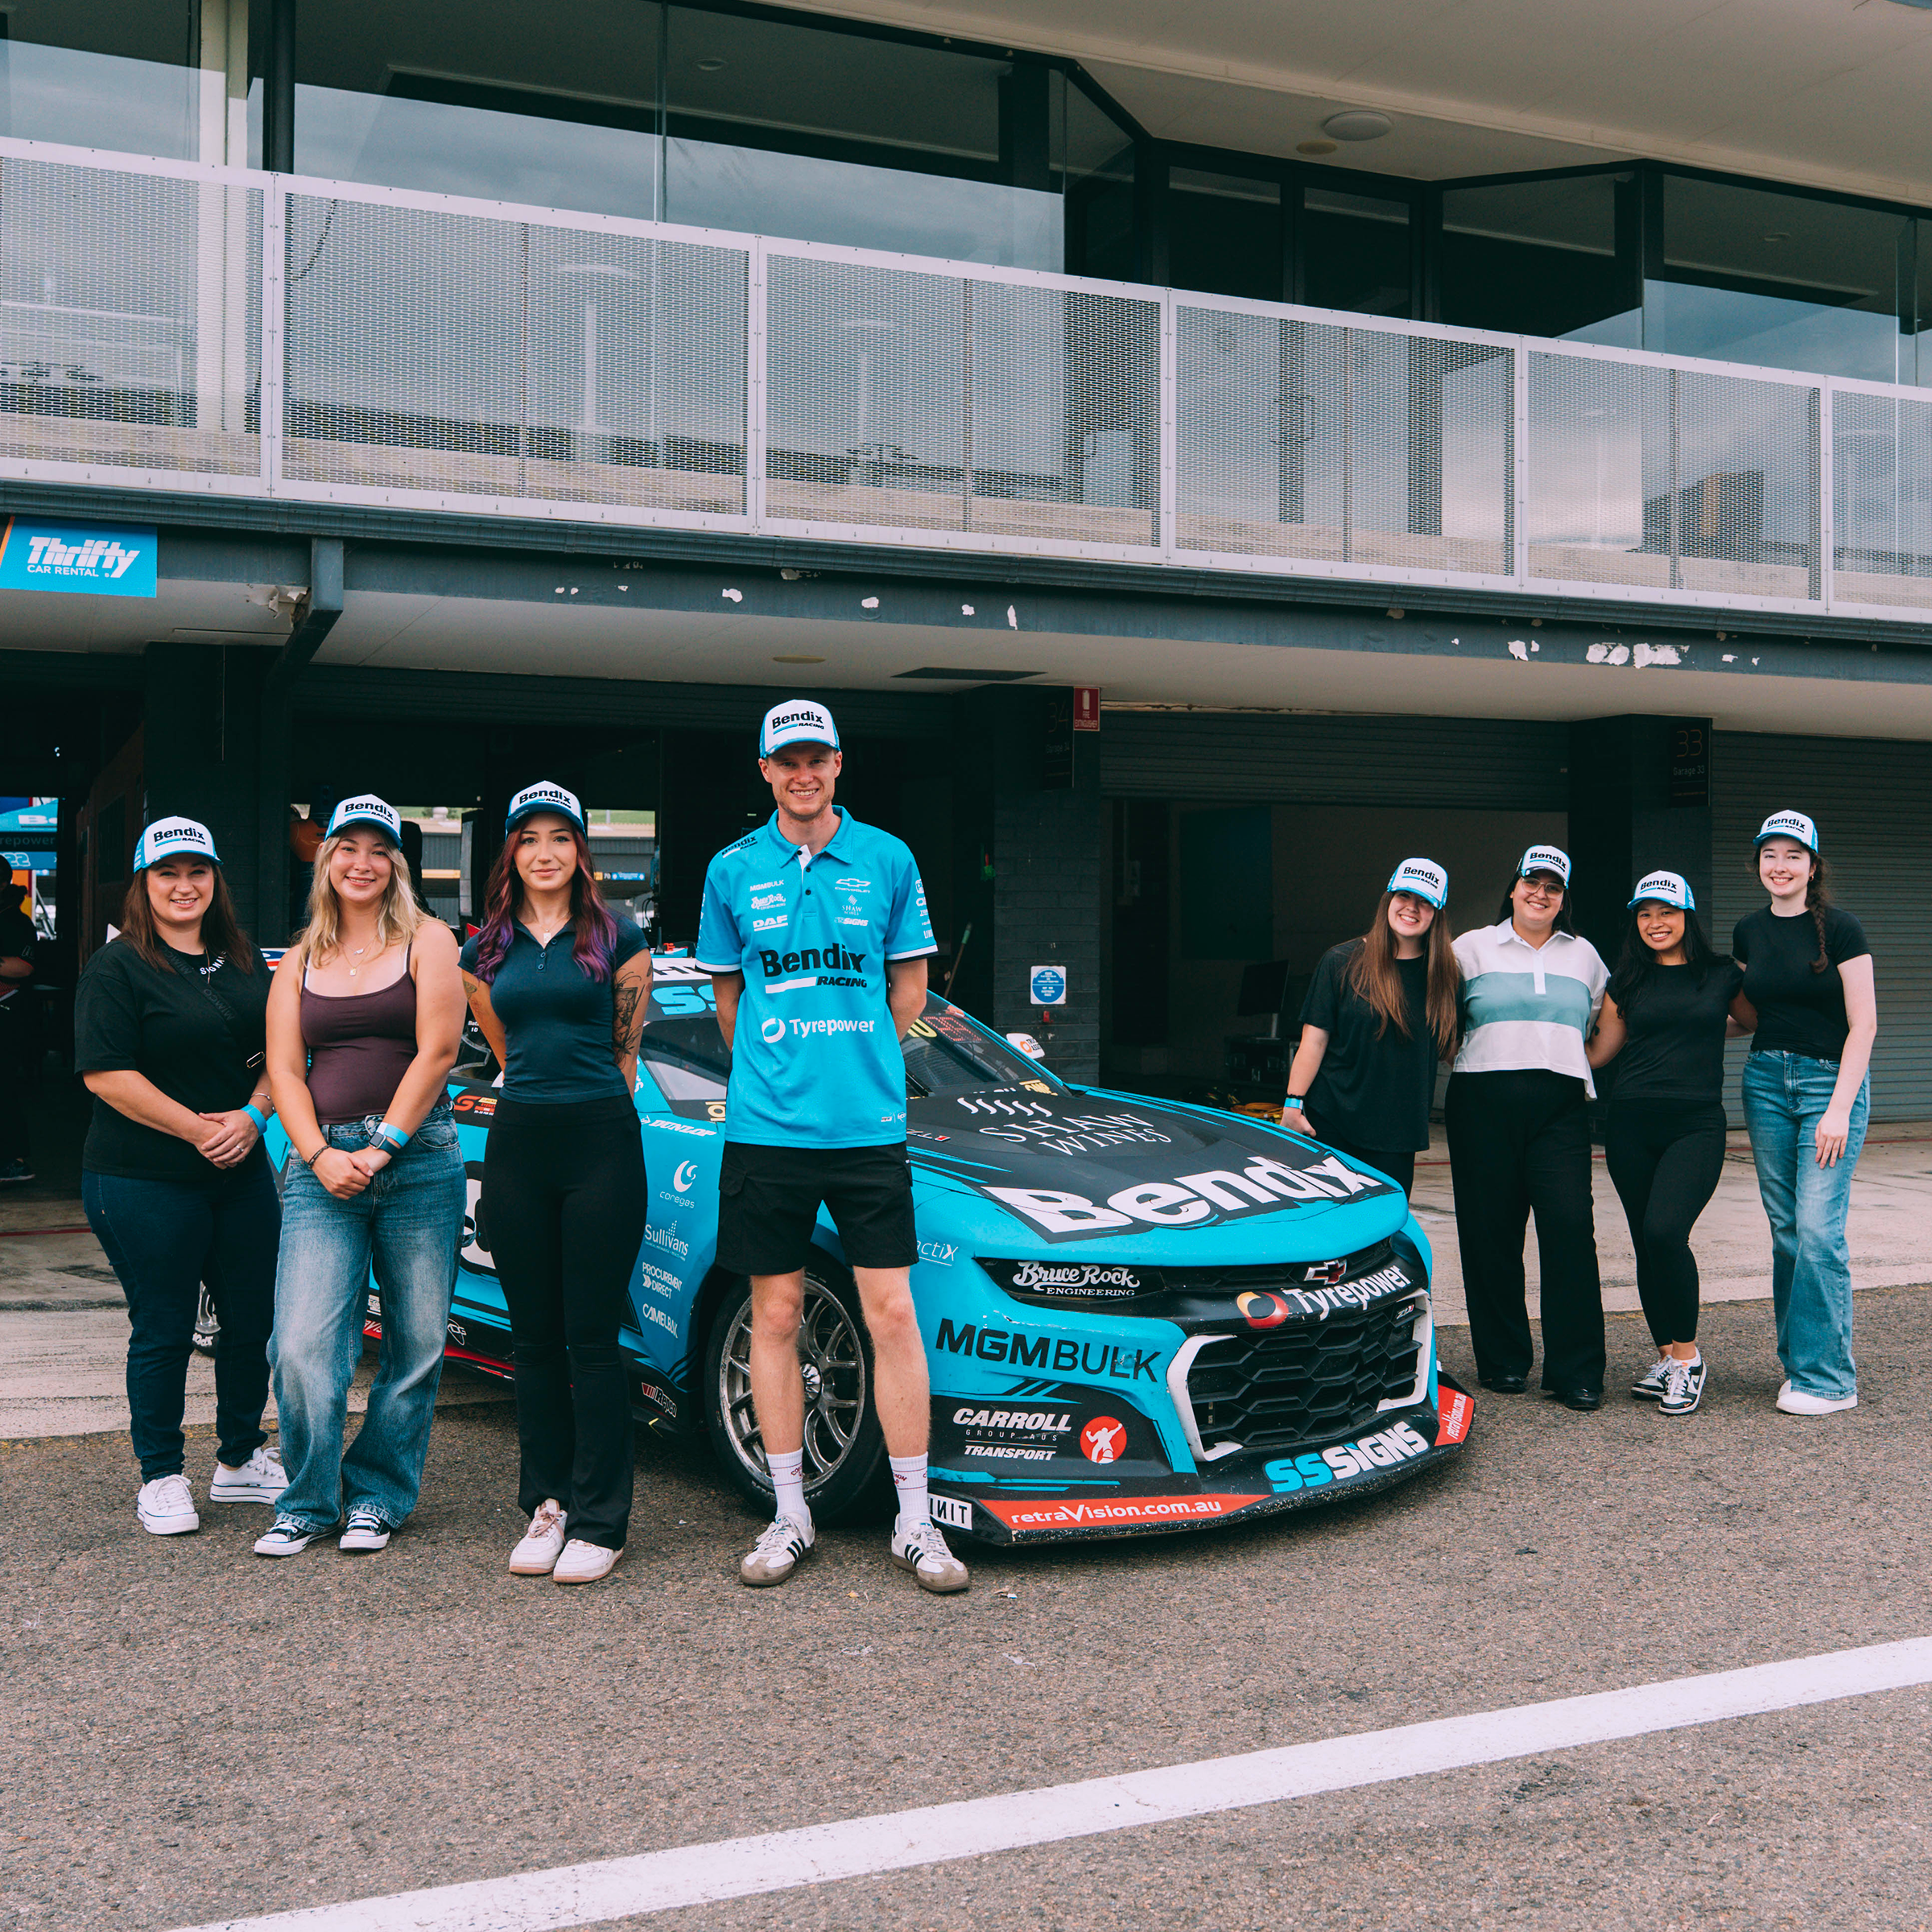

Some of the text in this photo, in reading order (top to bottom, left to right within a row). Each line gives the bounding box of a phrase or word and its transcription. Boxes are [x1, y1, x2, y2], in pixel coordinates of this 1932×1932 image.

[27, 536, 140, 578] Thrifty
[27, 565, 99, 577] CAR RENTAL
[771, 711, 824, 729] Bendix
[1677, 729, 1703, 758] 33
[519, 790, 571, 805] Bendix
[546, 798, 572, 808] RACING
[345, 803, 394, 820] Bendix
[1767, 818, 1806, 829] Bendix
[153, 827, 204, 842] Bendix
[181, 837, 206, 845] RACING
[1529, 852, 1567, 869] Bendix
[1403, 866, 1439, 885] Bendix
[1640, 879, 1677, 890] Bendix
[749, 879, 785, 892] MGMBULK
[753, 914, 787, 928] DAF
[759, 943, 866, 977] Bendix
[816, 976, 867, 988] RACING
[790, 1018, 874, 1038] Tyrepower
[648, 1119, 717, 1137] DUNLOP
[980, 1113, 1154, 1142] SHAW
[1038, 1128, 1172, 1156] WINES
[660, 1191, 695, 1208] coregas
[982, 1154, 1382, 1233] Bendix
[645, 1224, 689, 1256] Sullivans
[642, 1261, 683, 1292] PROCUREMENT
[1013, 1261, 1140, 1288] Bruce Rock
[651, 1280, 672, 1299] DIRECT
[1046, 1287, 1135, 1296] ENGINEERING
[1282, 1265, 1412, 1321] Tyrepower
[642, 1303, 678, 1339] CAMELBAK
[935, 1318, 1162, 1383] MGMBULK
[952, 1408, 1072, 1432] CARROLL
[966, 1429, 1058, 1441] GROUP AUS
[964, 1445, 1056, 1461] TRANSPORT
[1265, 1420, 1429, 1493] SSSIGNS
[1010, 1500, 1222, 1523] retraVision.com.au
